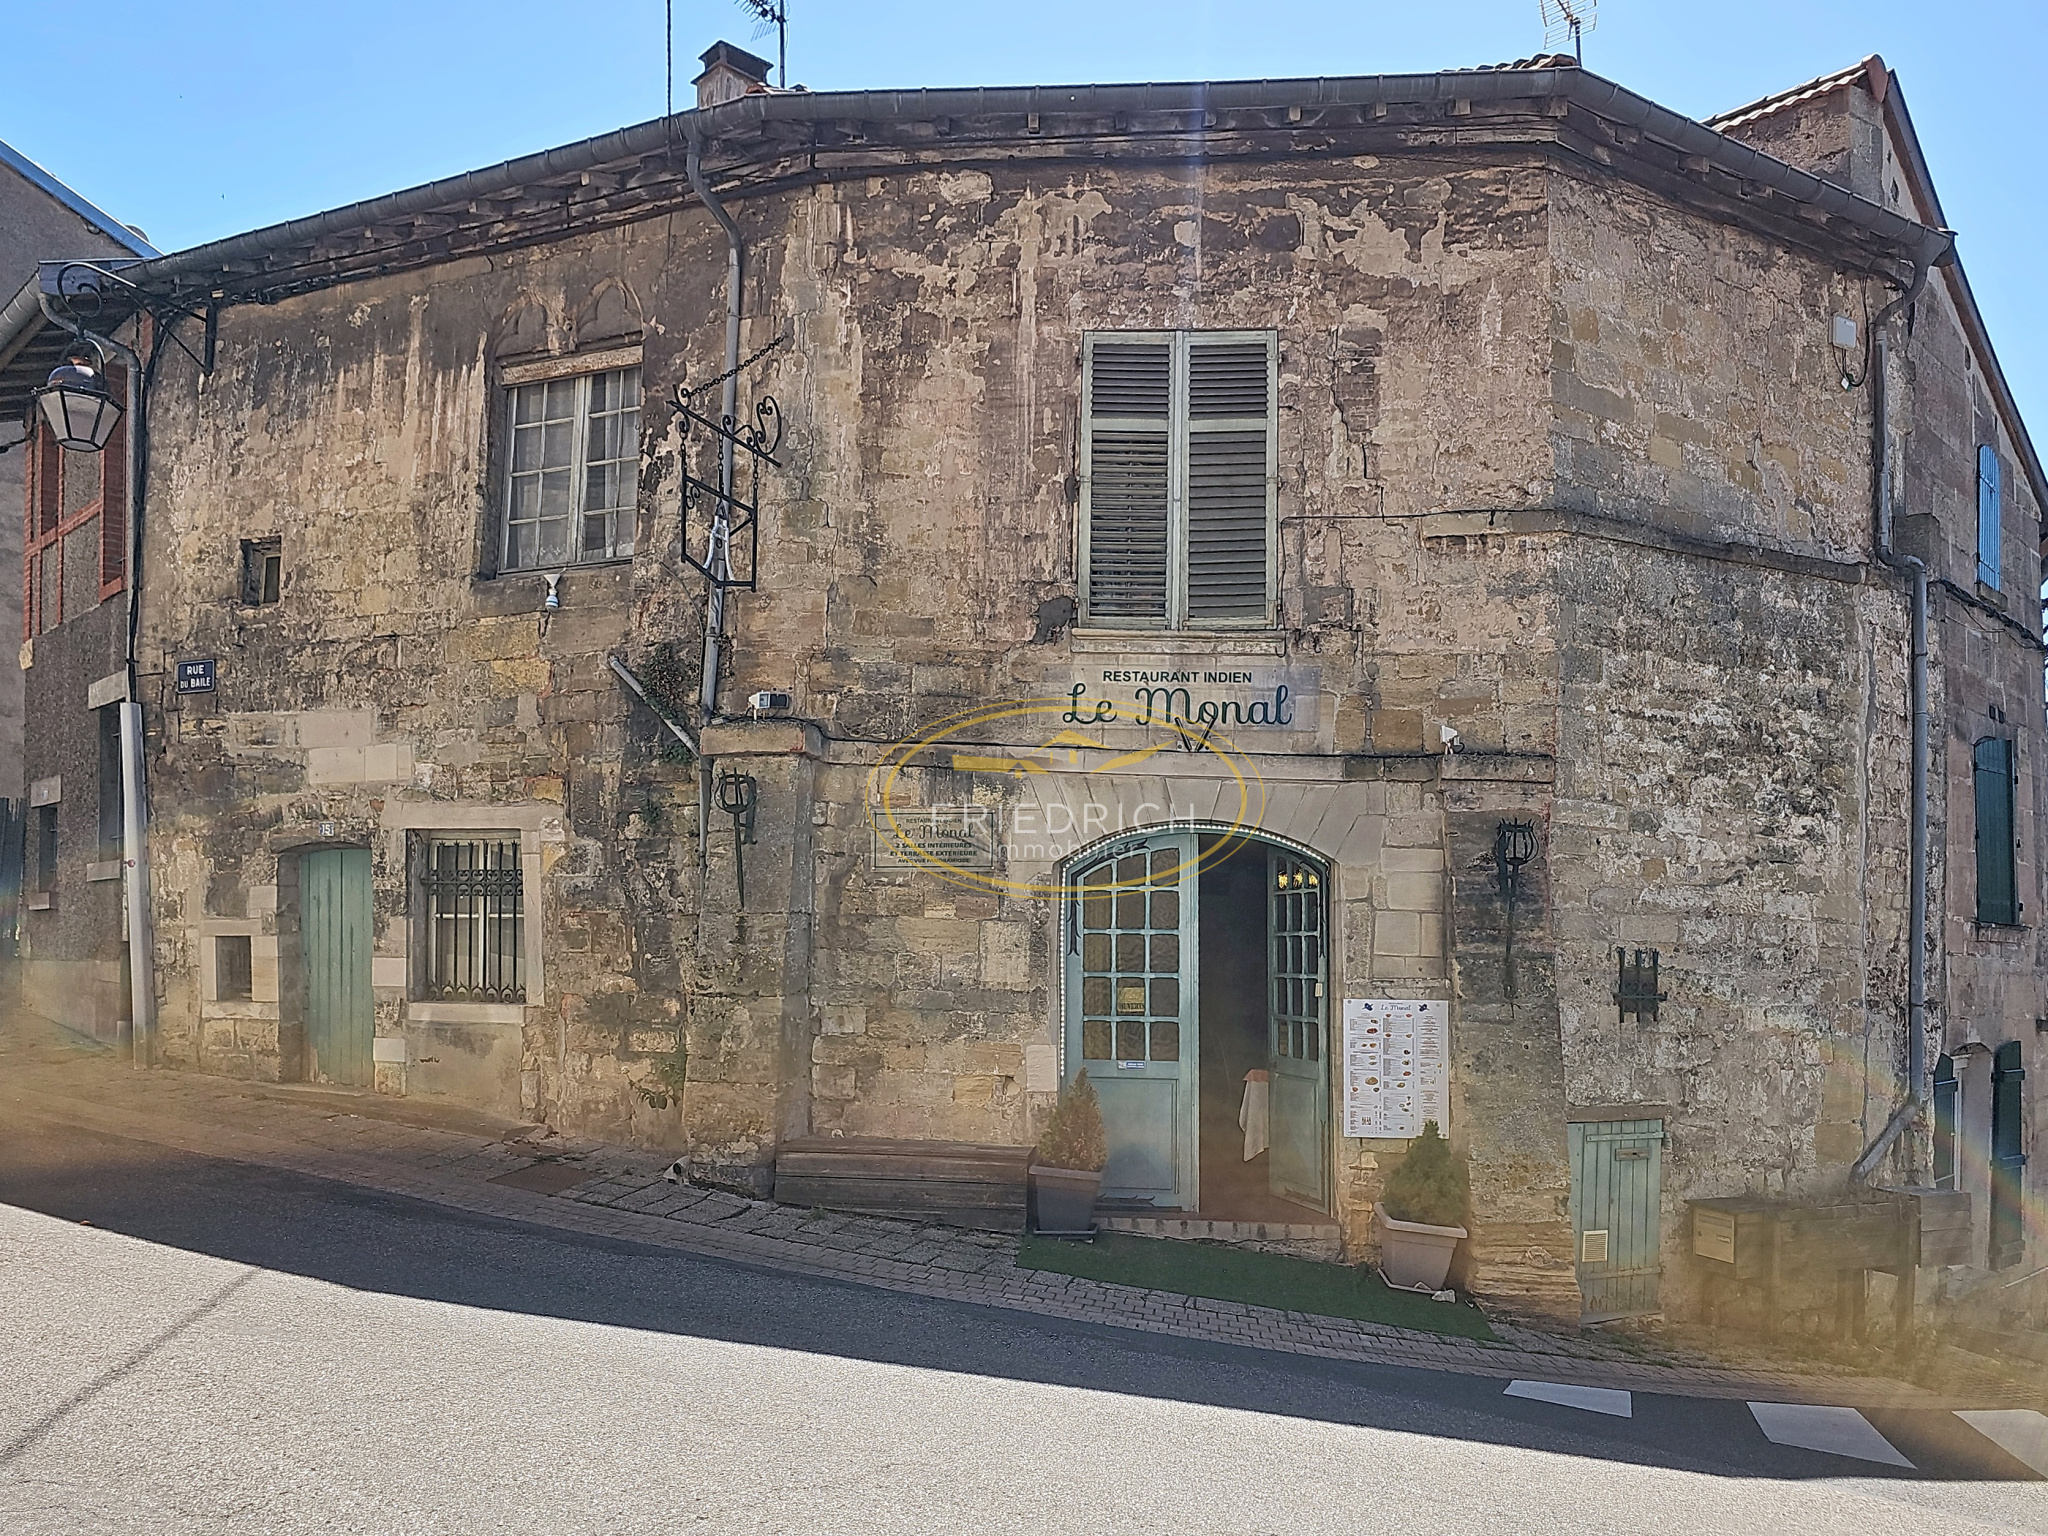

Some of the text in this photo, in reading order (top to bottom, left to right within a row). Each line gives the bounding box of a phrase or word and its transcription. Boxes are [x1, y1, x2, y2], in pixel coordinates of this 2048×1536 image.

[186, 664, 204, 675] RUE
[1102, 670, 1252, 683] RESTAURANT INDIEN
[180, 677, 211, 689] DU BAILE
[1062, 682, 1293, 726] Le Monal
[321, 824, 331, 834] 15
[892, 822, 976, 839] Le Monal
